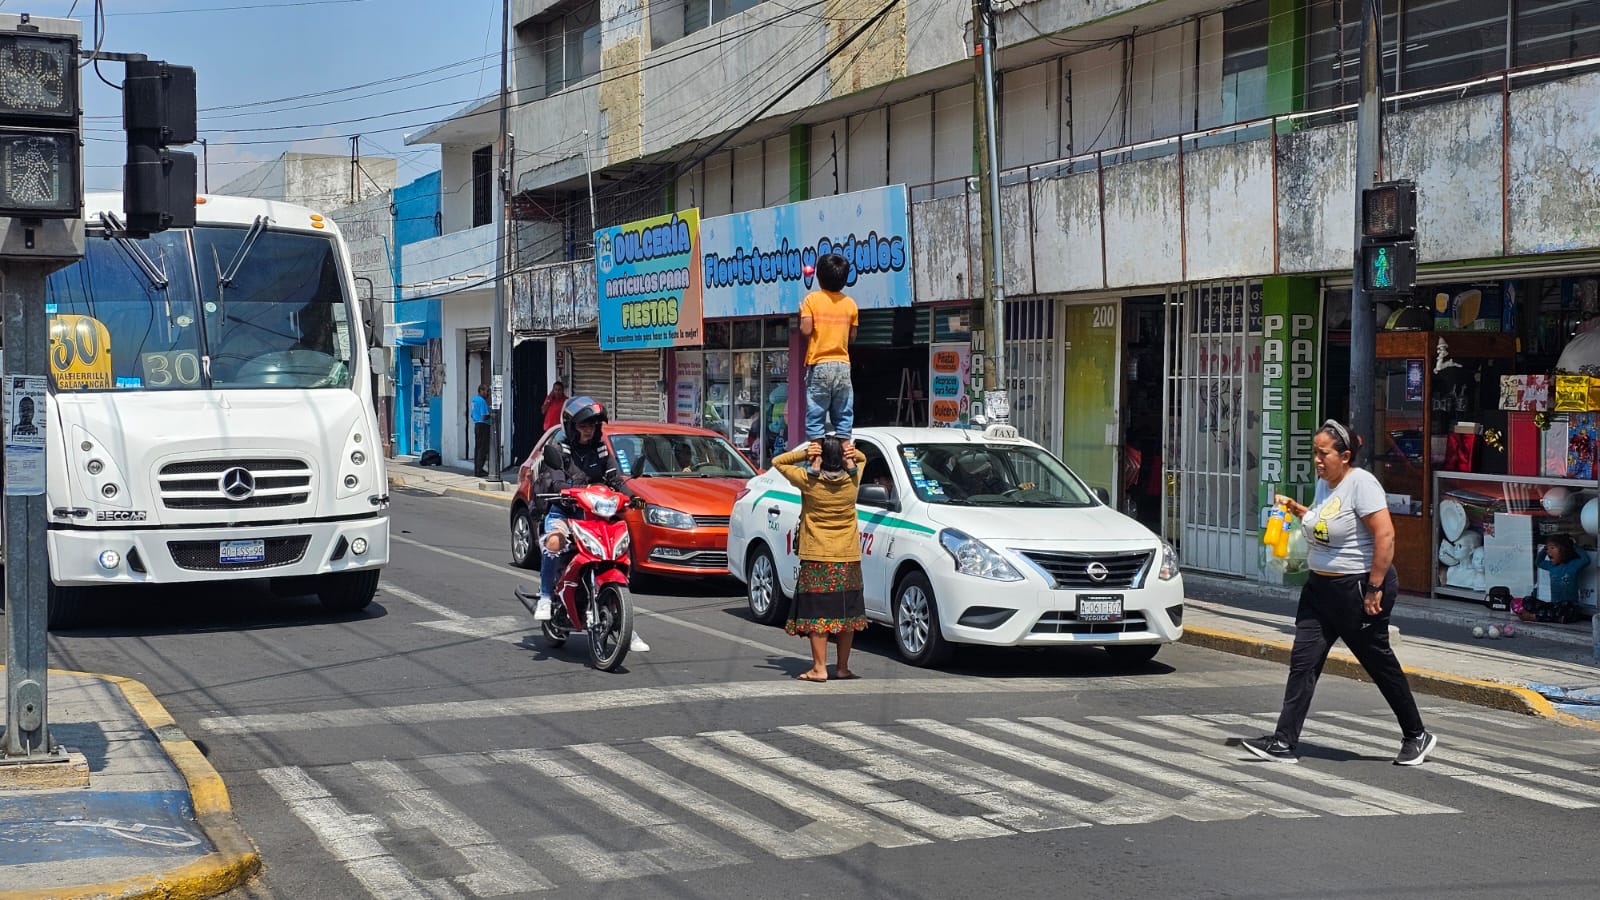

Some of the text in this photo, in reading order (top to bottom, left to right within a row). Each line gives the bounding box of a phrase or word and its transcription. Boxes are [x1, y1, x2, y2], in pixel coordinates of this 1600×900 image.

[614, 213, 691, 265] DULCERÍA
[704, 236, 801, 289] Floristería
[606, 267, 690, 299] ARTÍCULOS PARA
[621, 296, 678, 330] FIESTAS
[1093, 305, 1115, 328] 200
[1203, 317, 1217, 328] DE
[51, 316, 99, 372] 30
[147, 352, 200, 385] 30
[992, 428, 1016, 438] TAXI
[97, 511, 147, 521] BECCAR
[768, 520, 779, 532] TAXI
